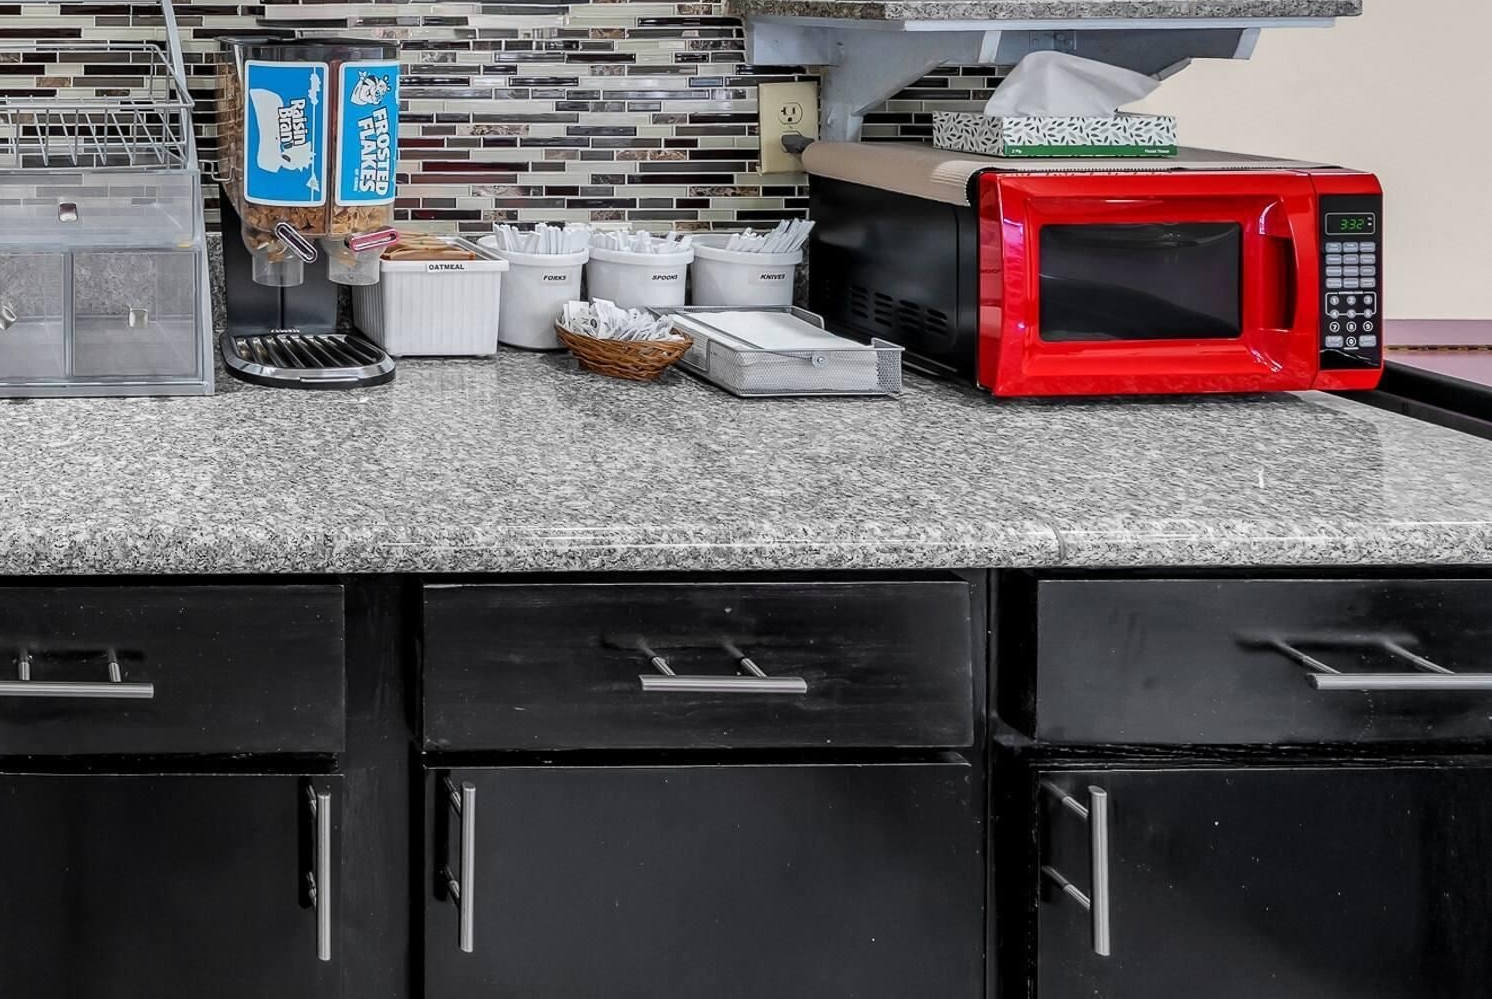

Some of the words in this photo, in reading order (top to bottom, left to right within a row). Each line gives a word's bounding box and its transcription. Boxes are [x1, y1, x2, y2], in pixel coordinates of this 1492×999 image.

[278, 106, 293, 147] Bran
[290, 98, 308, 147] Raisin
[358, 115, 377, 193] FLAKES
[372, 106, 390, 196] FROSTED
[428, 263, 465, 271] OATMEAL
[651, 273, 679, 281] SPOONS
[759, 273, 786, 281] KNIVES
